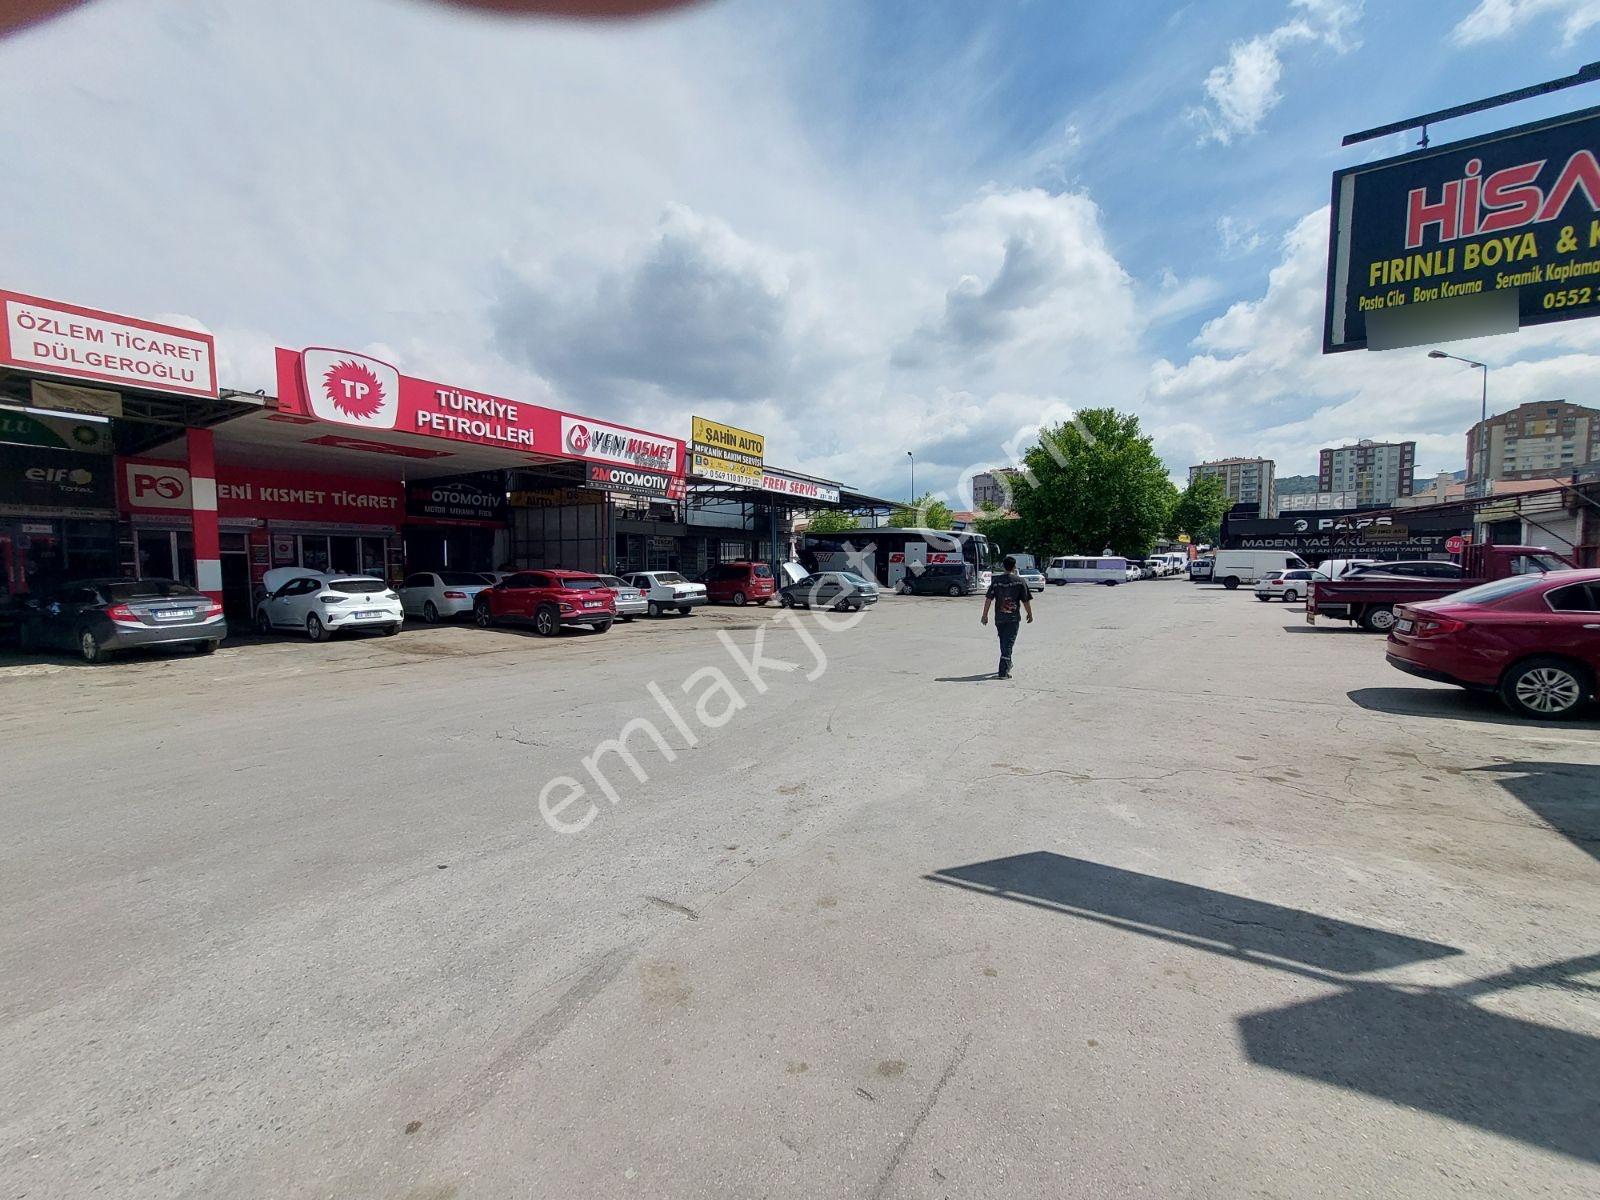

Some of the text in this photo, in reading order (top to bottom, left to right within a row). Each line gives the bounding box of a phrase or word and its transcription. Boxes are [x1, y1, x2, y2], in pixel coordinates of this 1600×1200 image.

[1369, 247, 1455, 287] FIRINLI
[1464, 232, 1538, 270] BOYA
[1556, 225, 1578, 254] &
[1359, 295, 1384, 312] Pasta
[1386, 290, 1405, 306] Cila
[1413, 286, 1438, 303] Boya
[1441, 279, 1482, 298] Koruma
[1495, 266, 1542, 290] Seramik
[1543, 287, 1590, 309] 0552
[17, 310, 203, 362] ÖZLEM TİCARET
[33, 342, 194, 382] DÜLGEROĞLU
[340, 379, 370, 400] TP
[436, 389, 519, 422] TÜRKİYE
[417, 410, 534, 446] PETROLLERİ
[705, 428, 762, 453] ŞAHİN AUTO
[594, 430, 675, 460] YENİ KISMET
[695, 444, 723, 459] MEKANİK
[25, 468, 68, 483] elf
[762, 476, 787, 491] FREN
[217, 483, 252, 500] ENİ
[260, 487, 326, 505] KISMET
[331, 490, 398, 509] TİCARET
[1241, 536, 1298, 547] MADENİ
[1302, 536, 1330, 547] YAĞ
